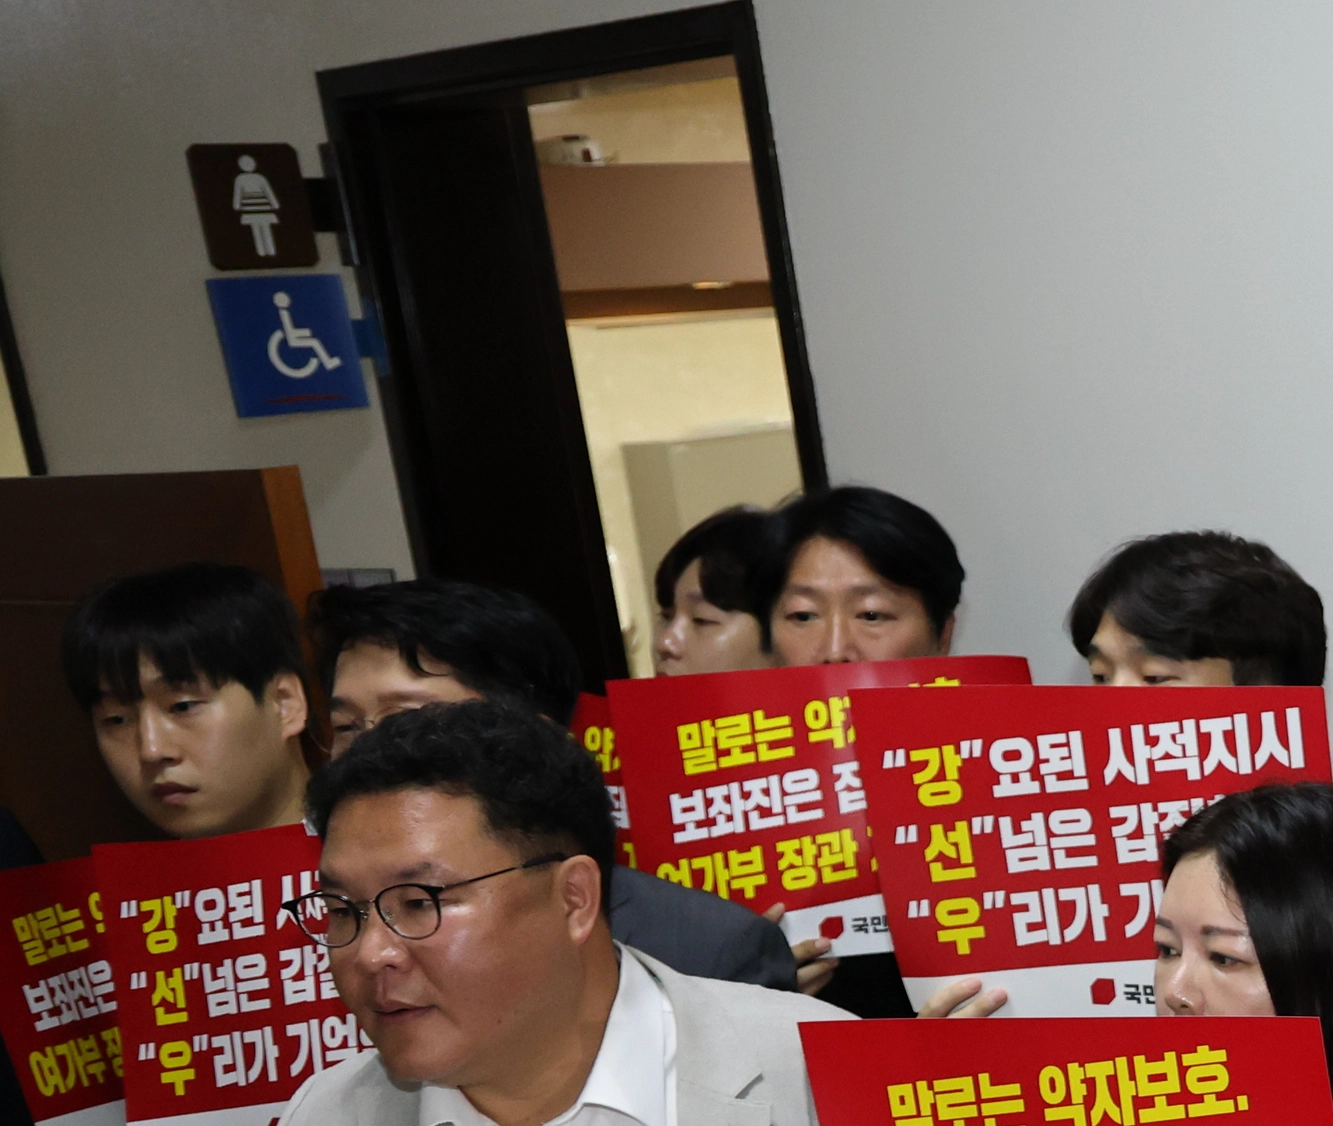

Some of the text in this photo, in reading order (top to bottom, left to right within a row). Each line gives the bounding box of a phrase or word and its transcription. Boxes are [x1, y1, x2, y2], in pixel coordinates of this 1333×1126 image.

[677, 710, 795, 776] 말로는
[882, 730, 1089, 807] “강”요된
[1103, 706, 1305, 787] 사적지시
[669, 768, 824, 844] 보좌진은
[775, 828, 859, 891] 장관
[895, 807, 1099, 883] “선”넘은
[12, 902, 89, 966] 말로는
[120, 879, 265, 954] “강”요된
[851, 915, 889, 934] 국민
[908, 883, 1109, 955] “우”리가
[22, 960, 117, 1032] 보좌진은
[130, 952, 271, 1027] “선”넘은
[29, 1036, 104, 1096] 여가부
[138, 1026, 279, 1096] “우”리가
